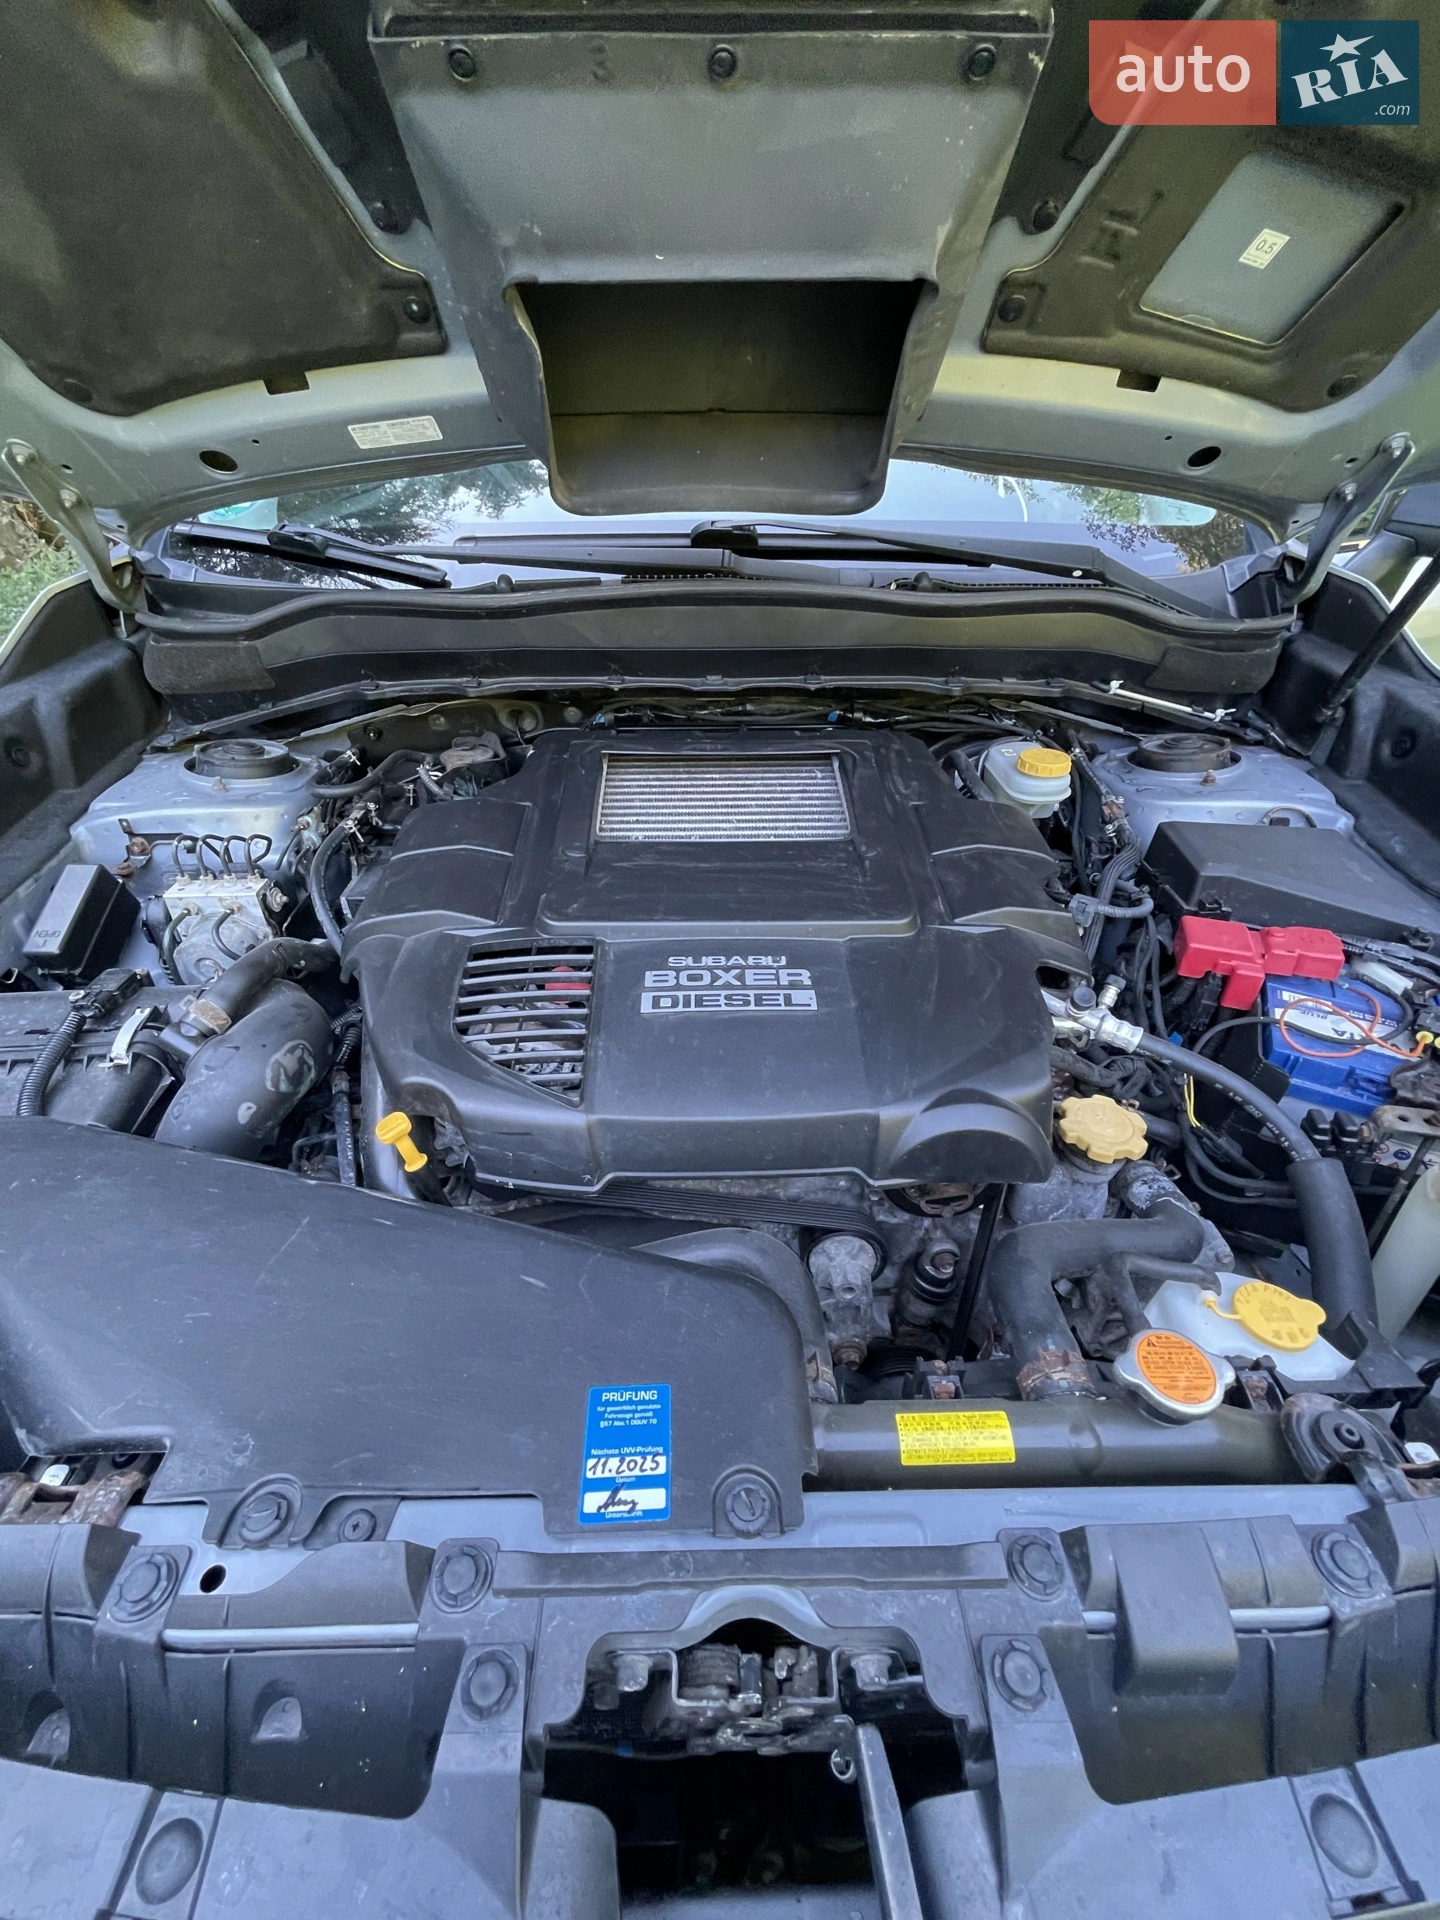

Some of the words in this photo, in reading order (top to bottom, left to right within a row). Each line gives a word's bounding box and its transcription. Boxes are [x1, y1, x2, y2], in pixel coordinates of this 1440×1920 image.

[1256, 239, 1277, 254] 0.5
[33, 930, 61, 938] OPEN
[668, 955, 787, 967] SUBARU
[644, 969, 812, 987] BOXER
[652, 993, 812, 1010] DIESEL
[602, 1390, 658, 1402] PRÜFUNG
[588, 1453, 664, 1475] 11.2025
